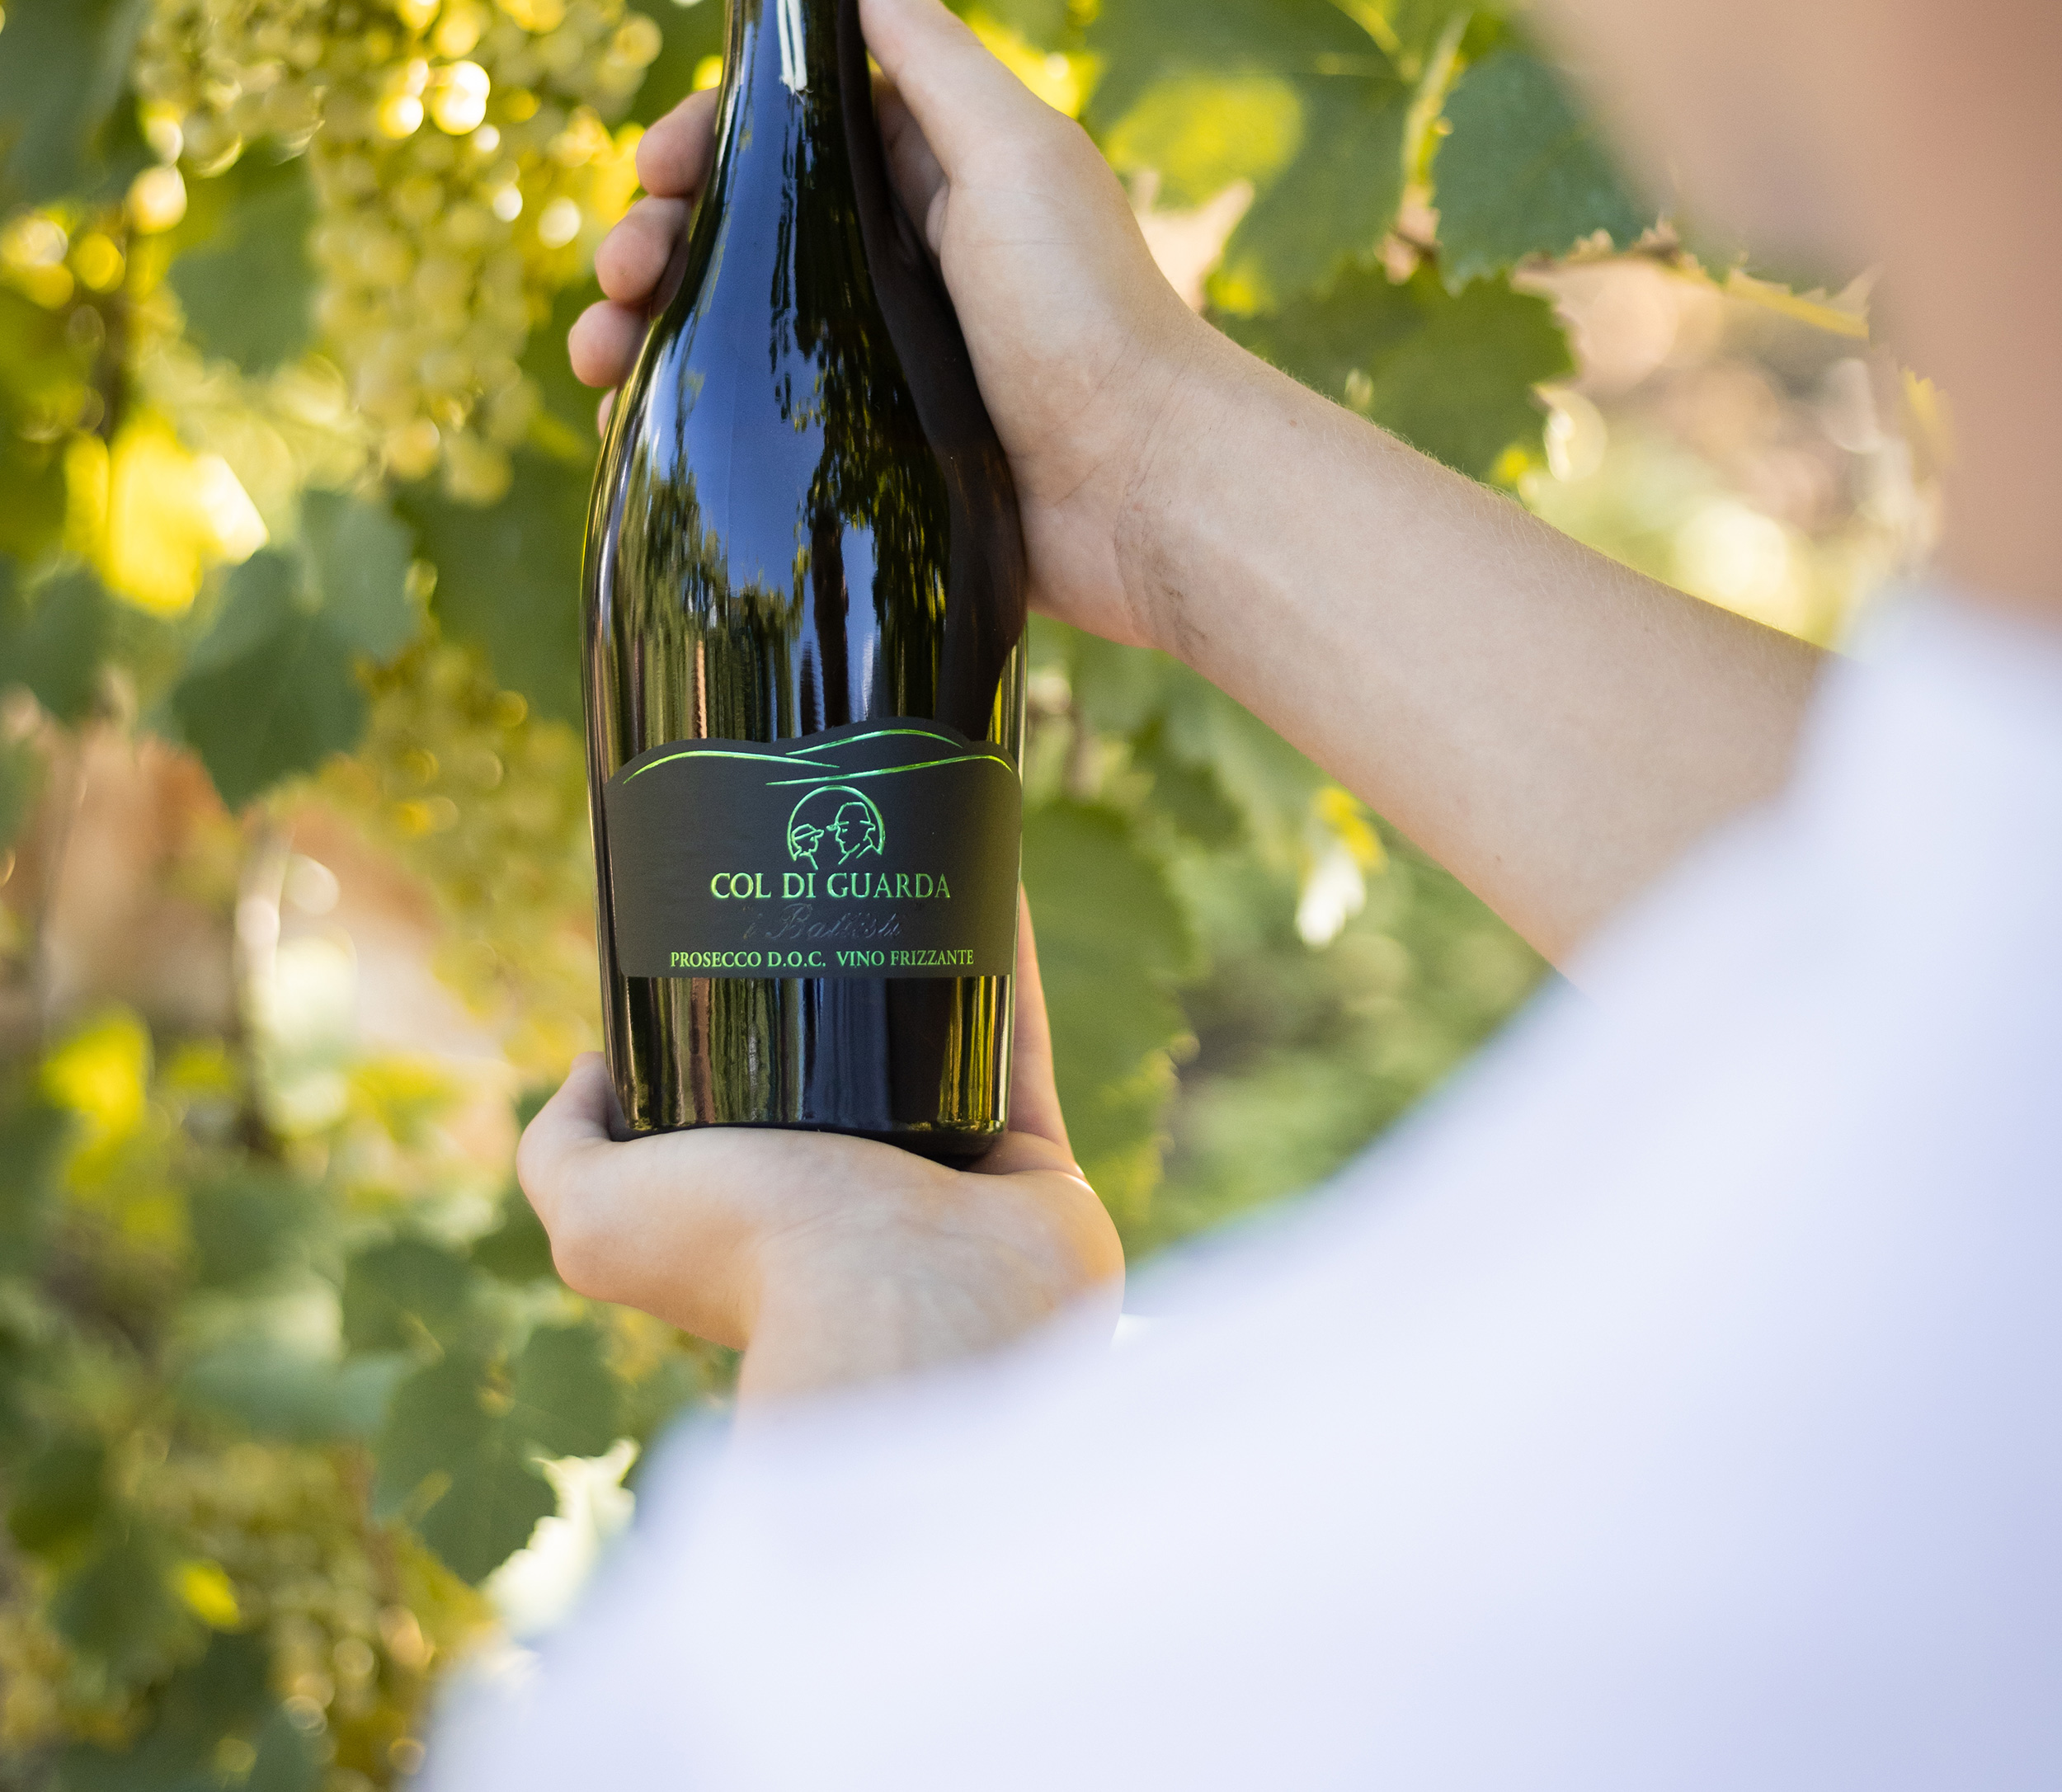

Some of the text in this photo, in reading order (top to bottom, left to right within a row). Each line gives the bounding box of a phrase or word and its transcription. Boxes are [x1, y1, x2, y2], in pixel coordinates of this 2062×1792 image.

[710, 872, 951, 899] COL DI GUARDA
[670, 949, 974, 968] PROSECCO D.O.C. VINO FRIZZANTE
